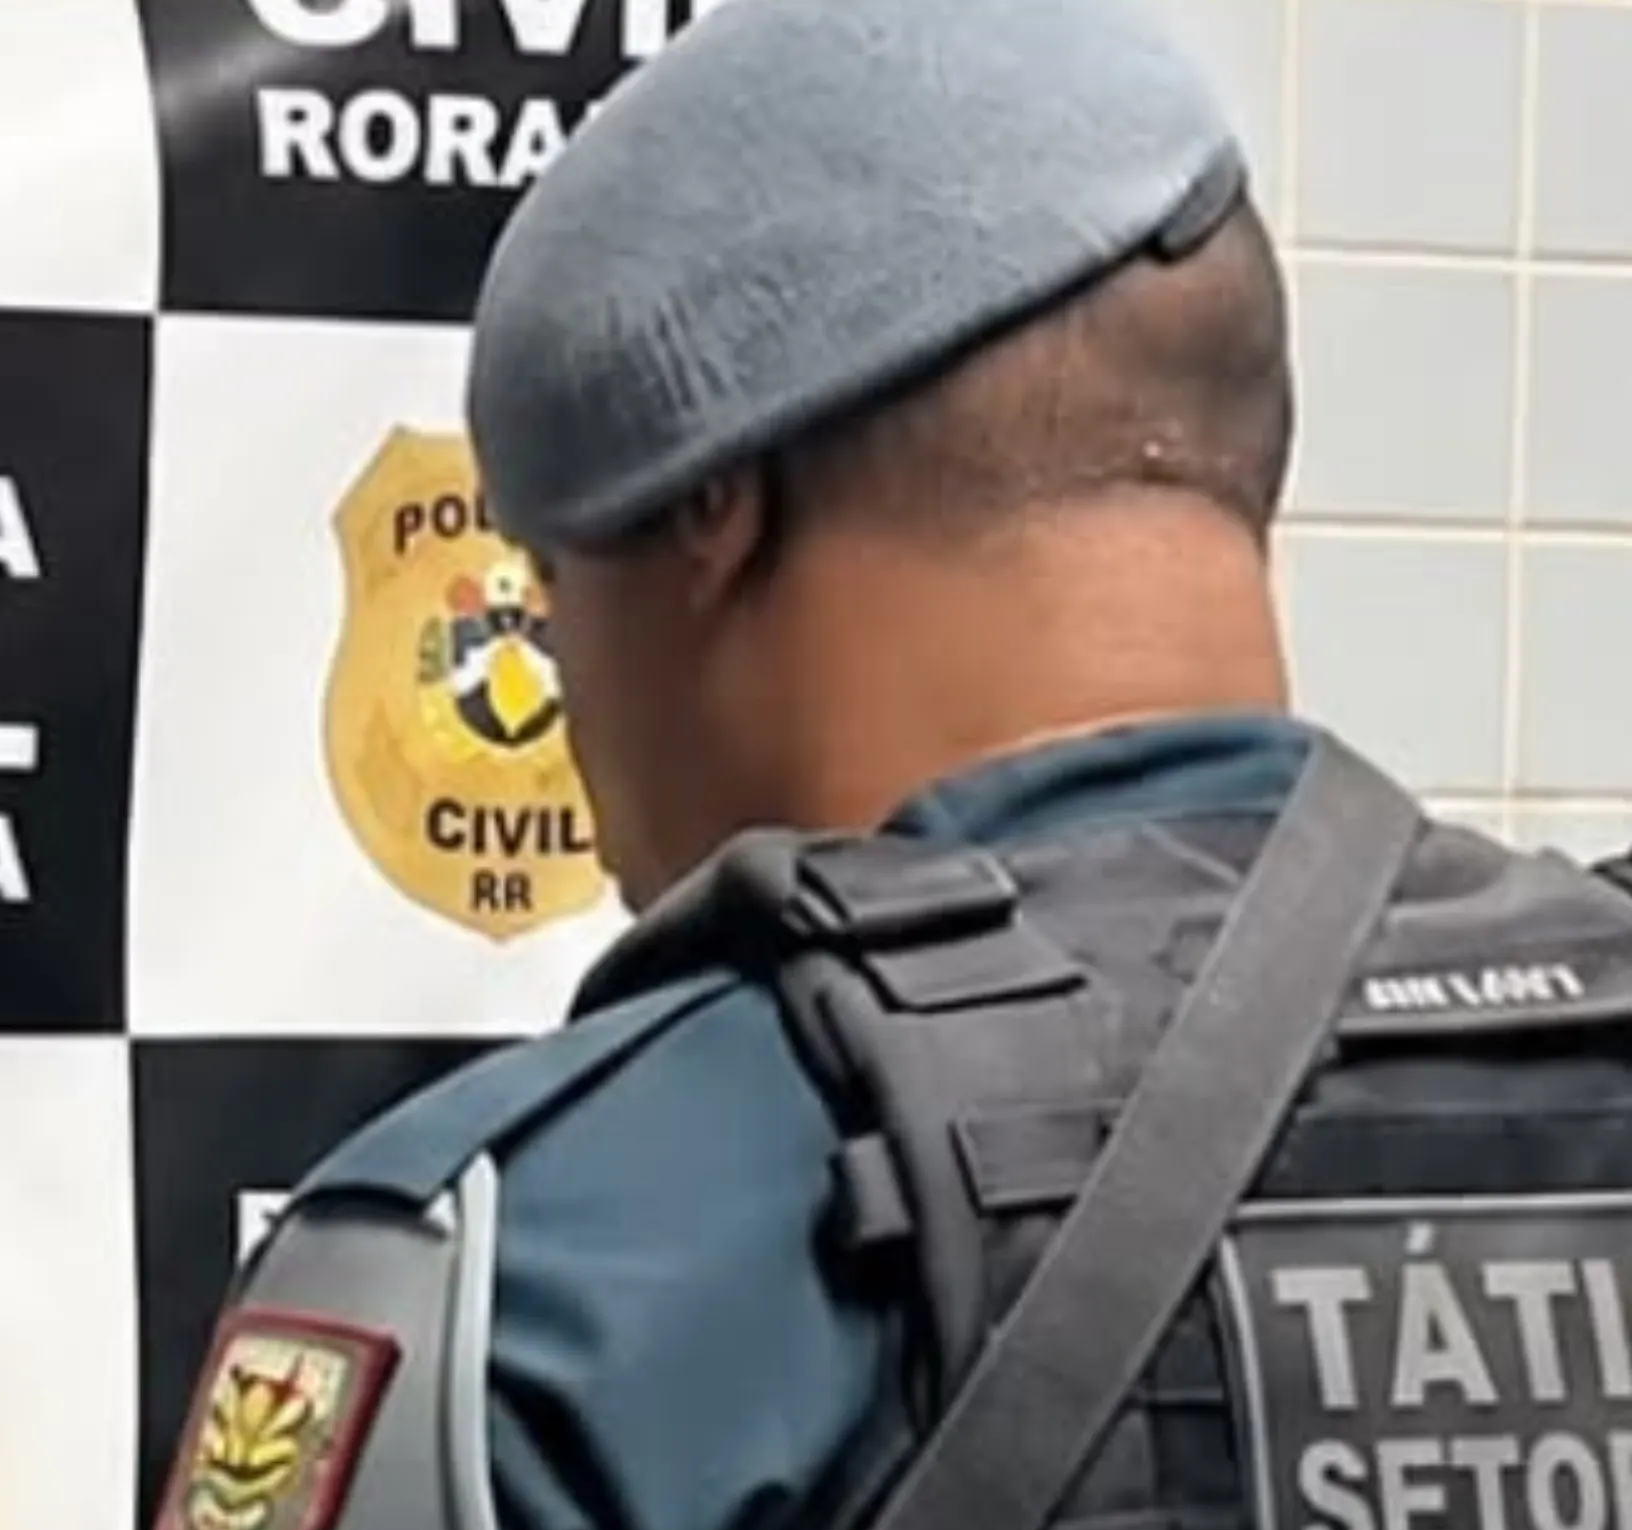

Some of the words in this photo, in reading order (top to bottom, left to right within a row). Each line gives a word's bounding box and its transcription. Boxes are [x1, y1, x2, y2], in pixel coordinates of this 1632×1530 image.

[257, 88, 604, 187] RORA
[425, 797, 592, 857] CIVIL
[472, 867, 534, 912] RR
[1272, 1222, 1632, 1409] TÁTI
